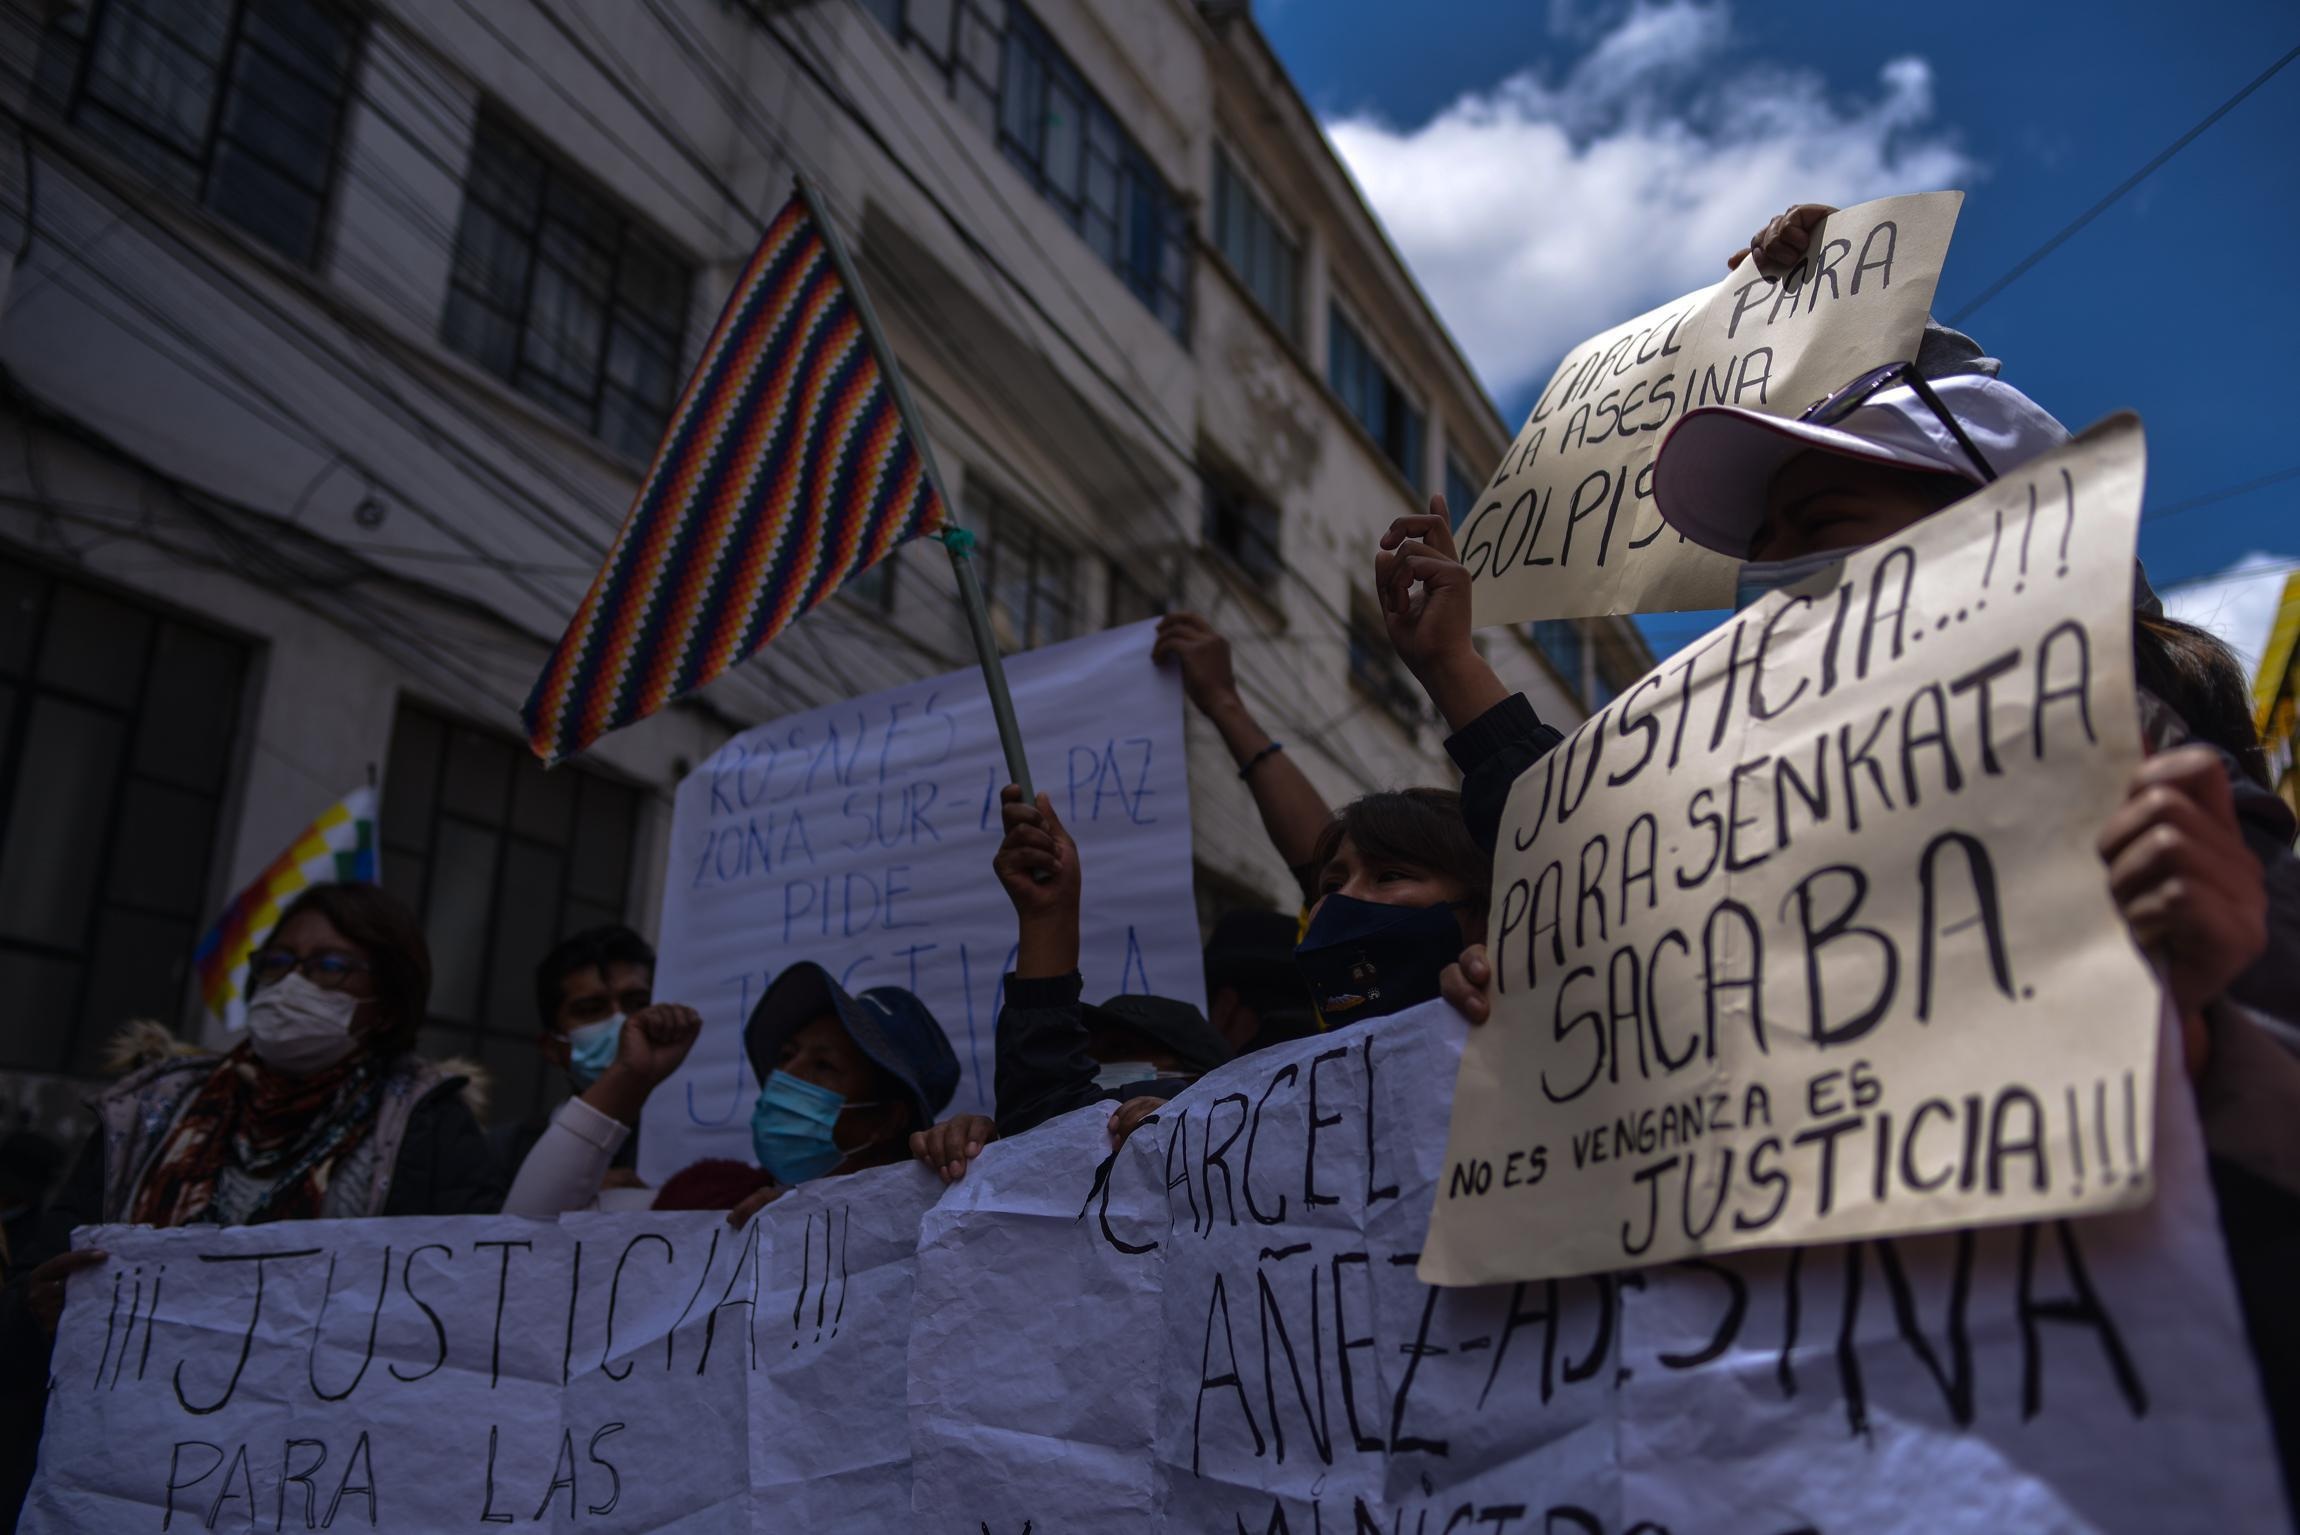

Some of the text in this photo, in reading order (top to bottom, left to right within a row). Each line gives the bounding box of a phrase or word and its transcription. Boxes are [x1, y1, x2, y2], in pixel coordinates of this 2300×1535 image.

[1530, 220, 1899, 425] CARCEL PARA
[1491, 346, 1775, 489] LA ASESINA
[1460, 464, 1687, 582] GOLPIS
[692, 808, 816, 889] ZONA
[1067, 738, 1158, 826] PAZ
[782, 866, 930, 944] PIDE
[1074, 1035, 1400, 1255] CARCEL
[1450, 1060, 1883, 1199] NO ES VENGANZA ES
[162, 1422, 626, 1533] PARA LAS
